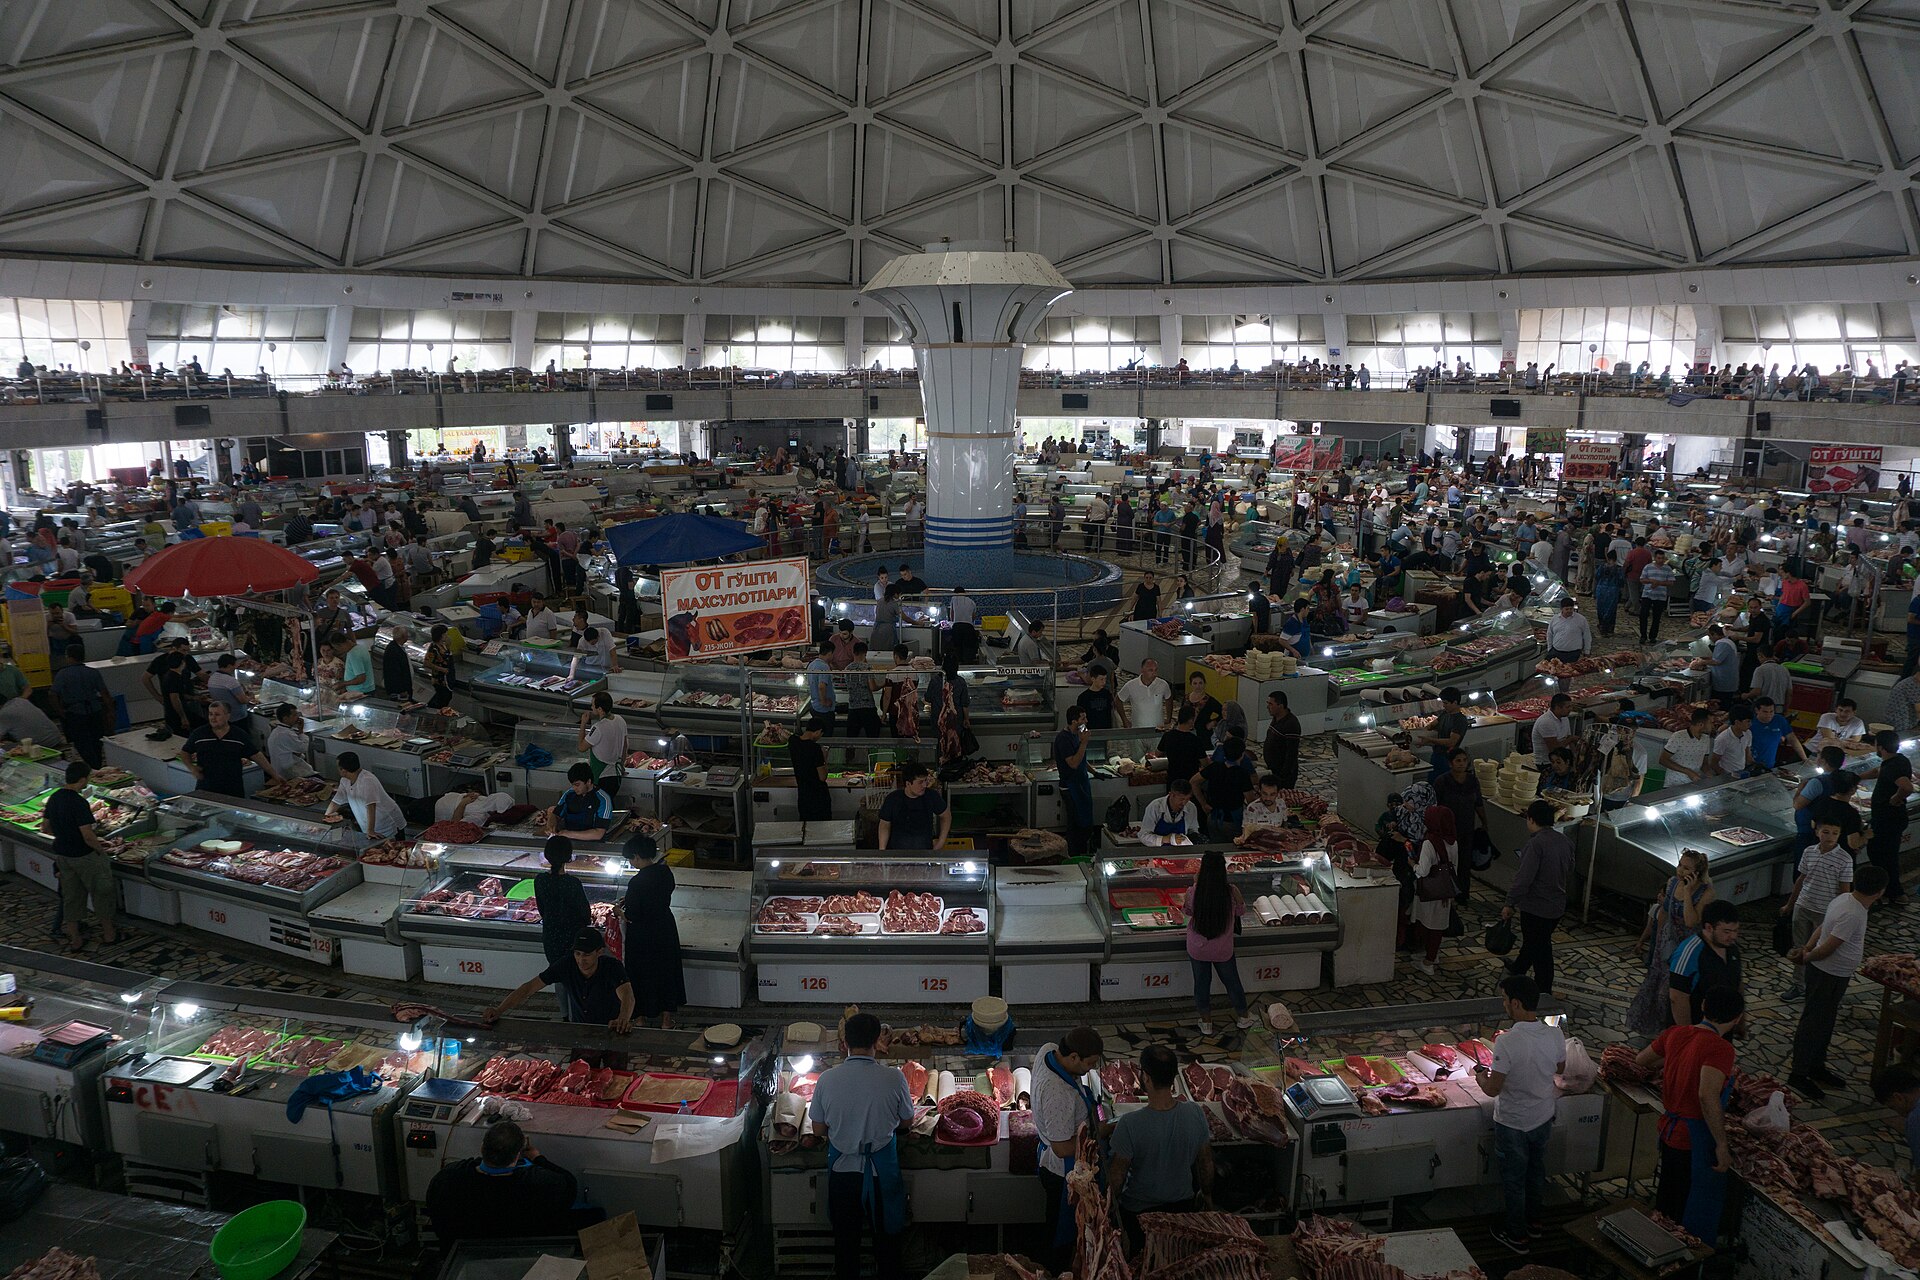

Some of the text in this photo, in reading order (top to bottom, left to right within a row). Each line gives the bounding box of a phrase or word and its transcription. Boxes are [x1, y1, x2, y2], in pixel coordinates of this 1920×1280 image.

[1579, 445, 1590, 453] ОТ
[1813, 448, 1880, 460] ОТ ГЎШТИ
[695, 571, 778, 592] ОТ ГЎШТИ
[677, 586, 798, 611] МАХСУЛОТЛАРИ
[208, 911, 227, 924] 130
[313, 939, 331, 953] 129
[459, 961, 483, 973] 128
[1255, 966, 1281, 980] 123
[801, 977, 827, 990] 126
[921, 978, 948, 991] 125
[1144, 974, 1169, 987] 124
